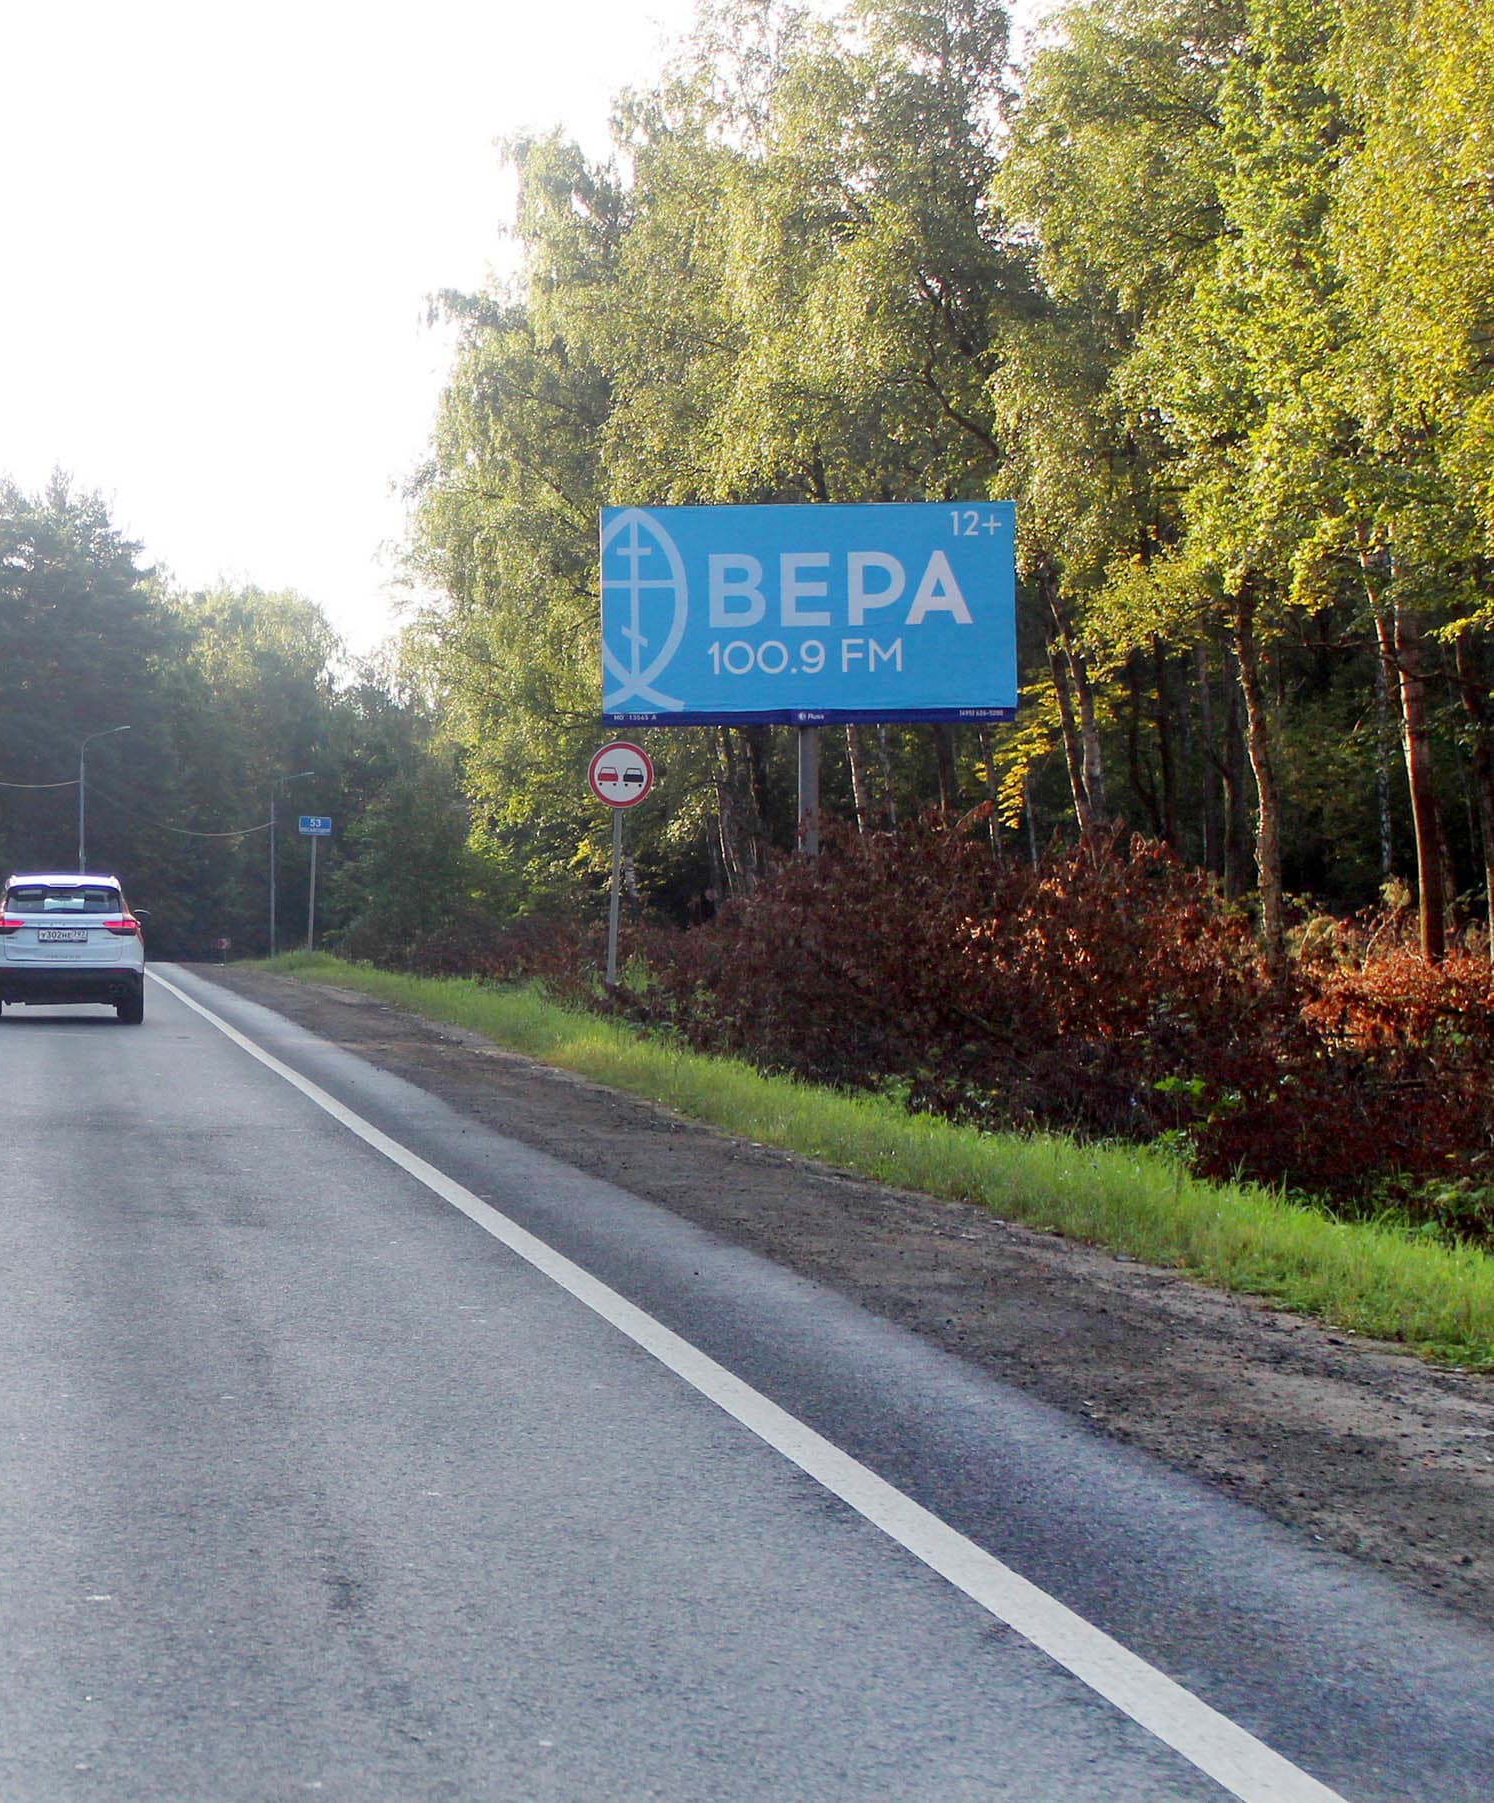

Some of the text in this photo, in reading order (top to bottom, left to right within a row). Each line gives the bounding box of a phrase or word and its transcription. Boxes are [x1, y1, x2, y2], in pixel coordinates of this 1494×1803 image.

[950, 510, 1003, 536] 12+
[708, 550, 973, 628] ВЕРА
[707, 638, 904, 675] 100.9 FM
[309, 818, 322, 828] 53
